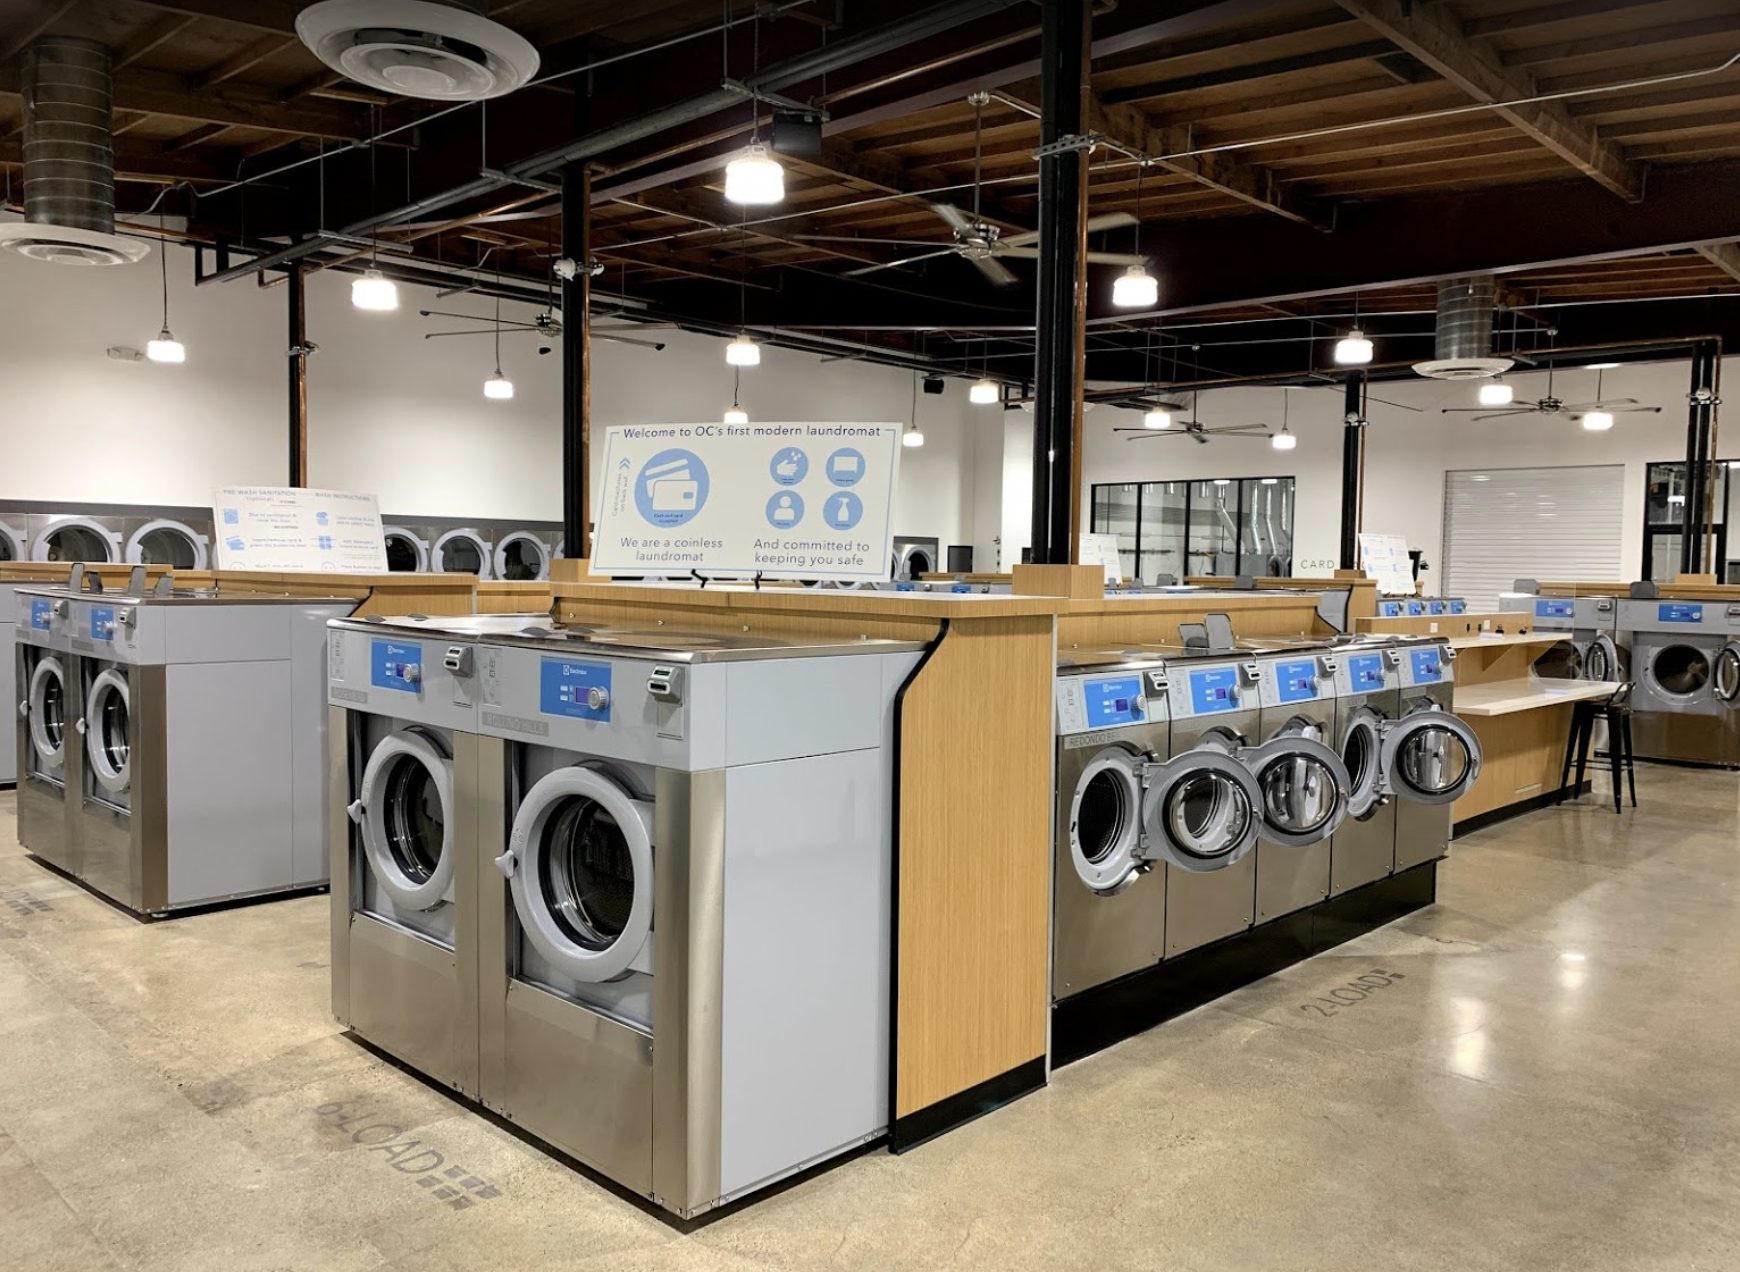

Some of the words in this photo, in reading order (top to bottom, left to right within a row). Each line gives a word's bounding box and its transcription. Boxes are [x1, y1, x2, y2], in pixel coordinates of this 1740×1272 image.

[623, 427, 677, 439] Welcome
[679, 427, 692, 437] to
[695, 426, 724, 437] OC's
[727, 425, 750, 436] first
[753, 425, 802, 436] modern
[806, 425, 881, 437] laundromat
[620, 536, 641, 548] We
[642, 539, 661, 548] are
[664, 539, 671, 548] a
[673, 537, 723, 549] coinless
[753, 537, 779, 550] And
[783, 538, 854, 552] committed
[856, 540, 870, 552] to
[635, 549, 704, 562] laundromat
[754, 552, 806, 567] keeping
[809, 556, 834, 568] you
[837, 554, 864, 566] safe
[1300, 559, 1335, 570] CARD
[1069, 733, 1106, 747] REDONDO
[1299, 974, 1393, 1018] 2-LOAD
